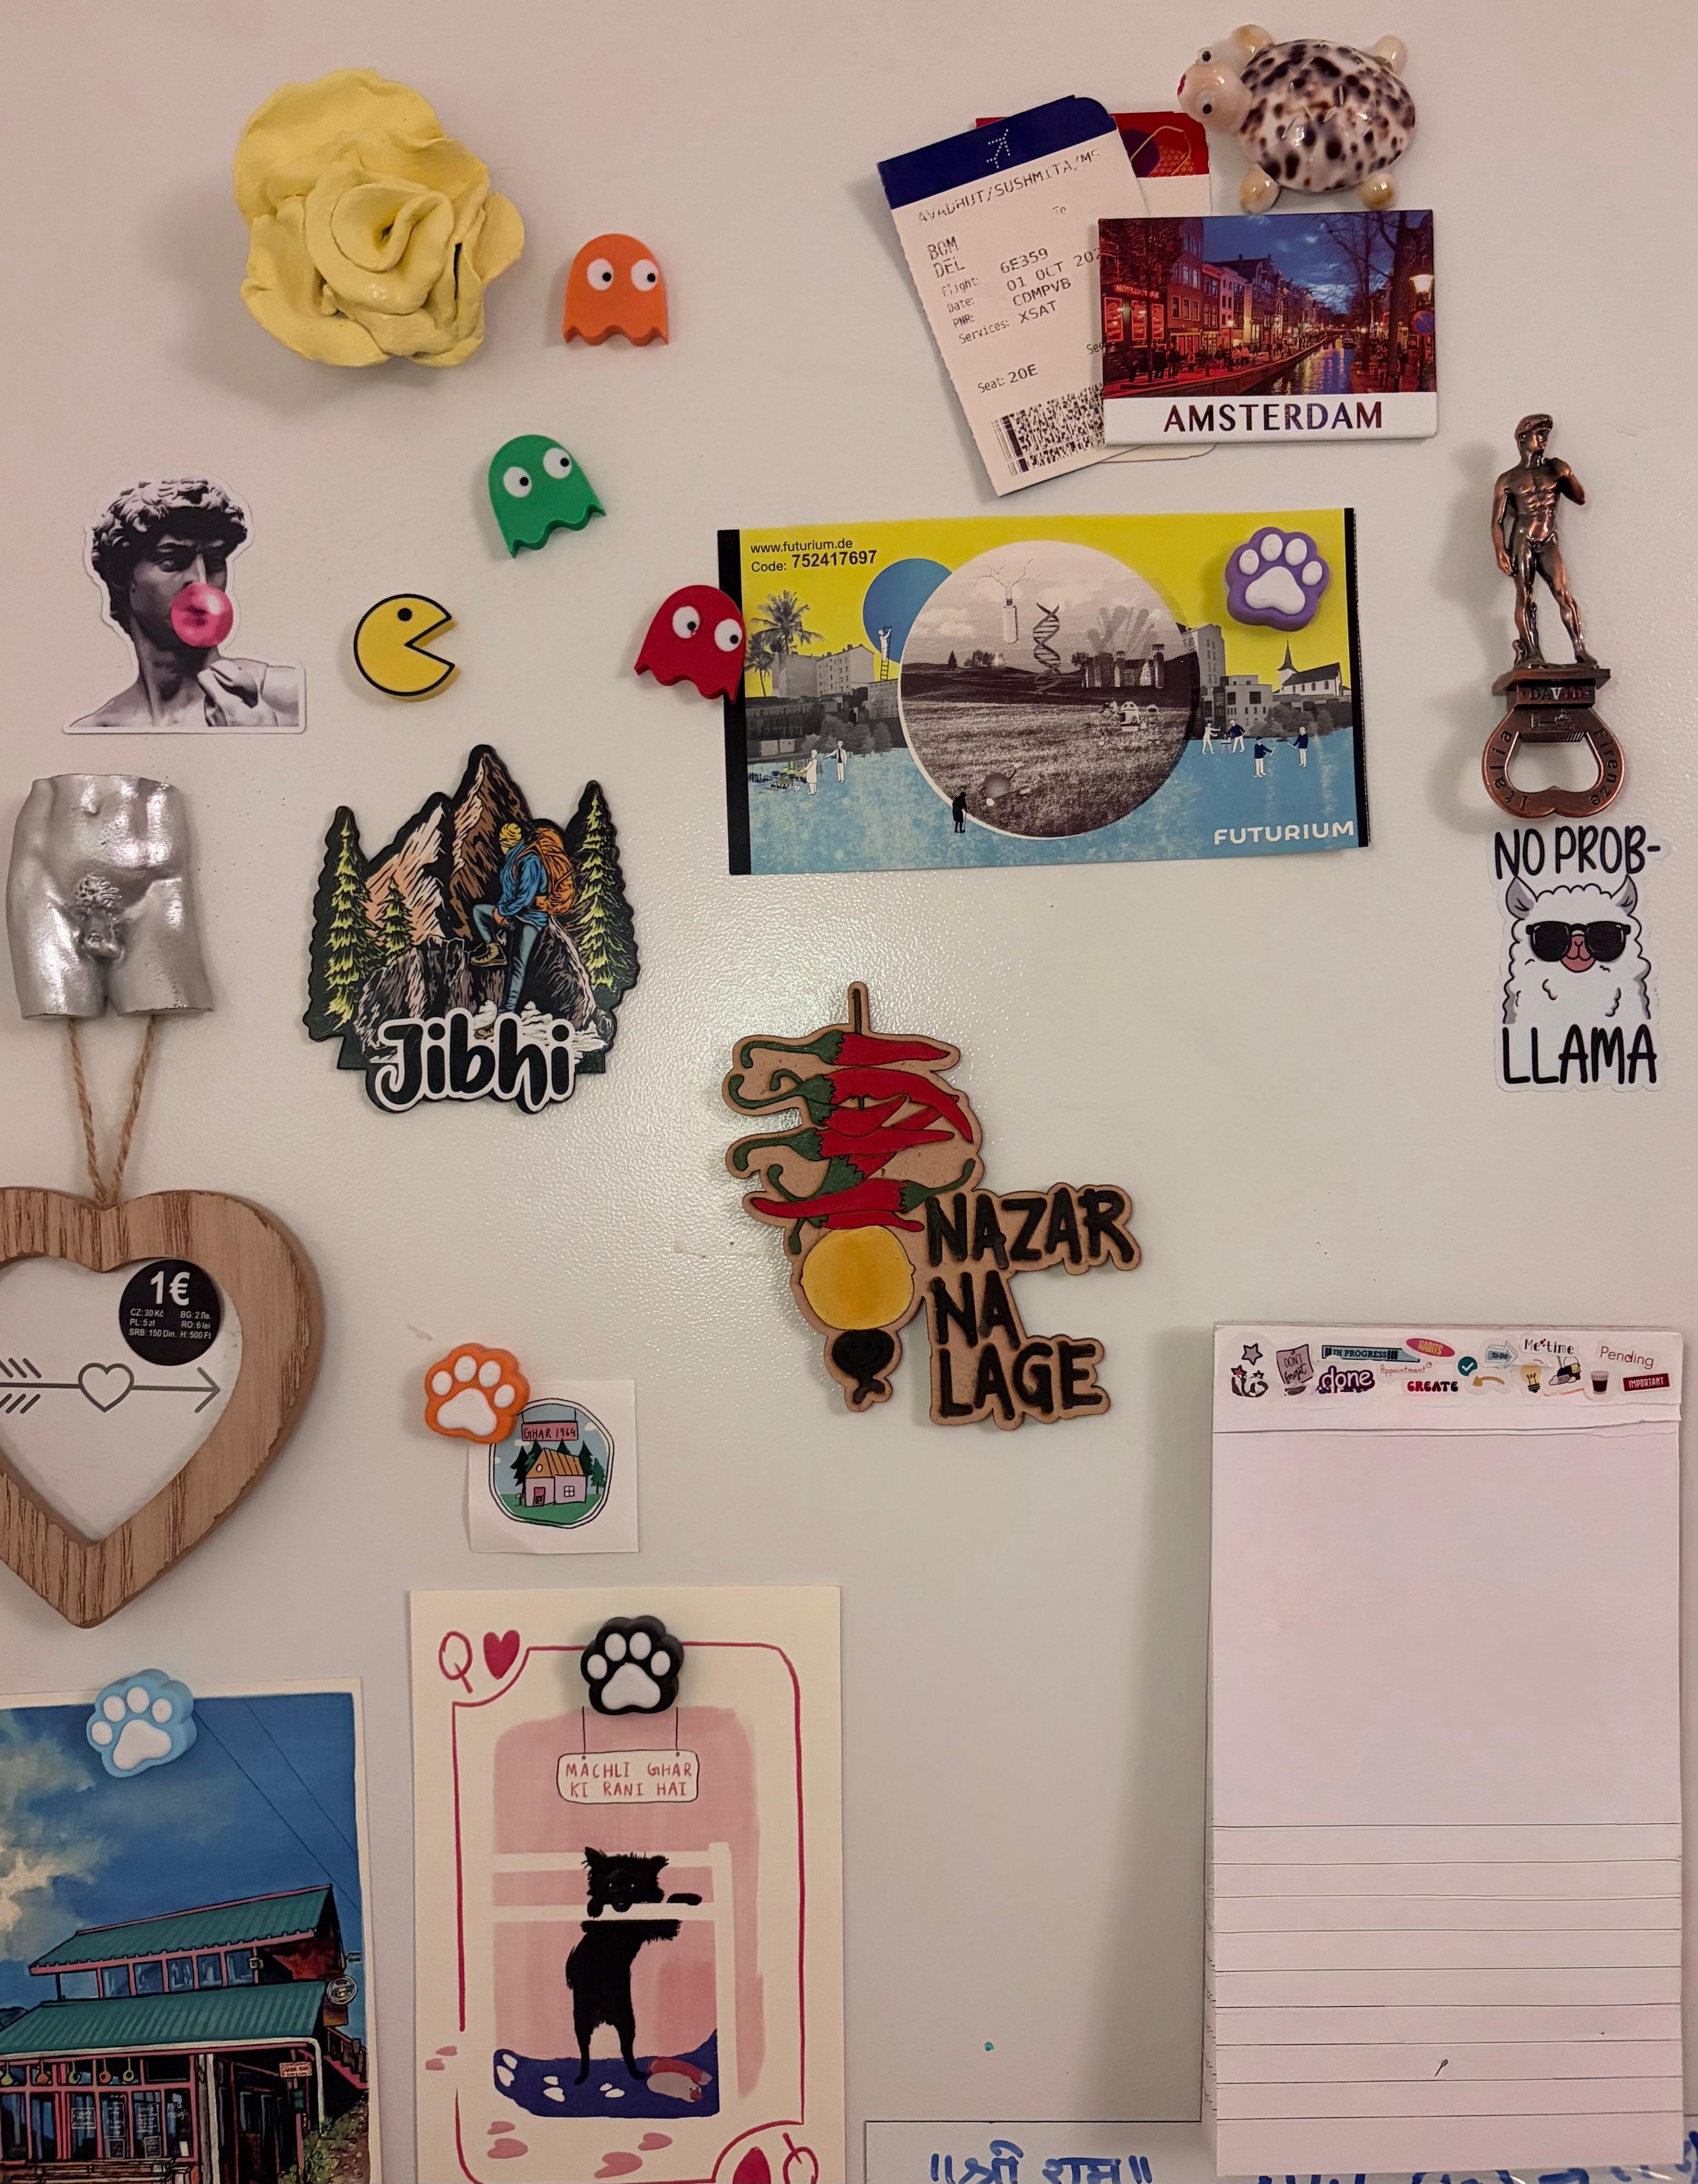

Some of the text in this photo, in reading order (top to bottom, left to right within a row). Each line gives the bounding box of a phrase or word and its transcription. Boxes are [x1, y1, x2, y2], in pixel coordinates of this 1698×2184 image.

[927, 236, 959, 260] BOM
[933, 257, 965, 278] DEL
[942, 248, 1048, 297] Flight: 6E359
[947, 297, 975, 313] Date:
[1036, 261, 1063, 280] OCT
[1073, 247, 1100, 267] 202
[953, 278, 1071, 328] PNR: CDMPVB
[958, 300, 1056, 344] Services: XSAT
[978, 364, 1038, 393] Seat: 20E
[1163, 402, 1382, 432] AMSTERDAM
[751, 538, 853, 553] www.futurium.de
[751, 550, 877, 572] Code: 752417697
[1529, 687, 1584, 700] DAVID
[1589, 728, 1618, 805] Firenze
[1214, 820, 1355, 845] FUTURIUM
[1494, 825, 1661, 879] NO PROB-
[378, 1011, 572, 1109] Jibhi
[1502, 1024, 1657, 1084] LLAMA
[925, 1188, 1135, 1269] NAZAR
[150, 1270, 191, 1306] 1€
[930, 1270, 1021, 1350] NA
[163, 1329, 177, 1338] Din.
[1344, 1349, 1387, 1359] PROGRESS
[1418, 1339, 1443, 1355] HABITS
[1524, 1339, 1574, 1354] Me time
[1600, 1346, 1654, 1370] Pending
[938, 1341, 1103, 1421] LAGE
[1284, 1363, 1307, 1383] forget
[1321, 1367, 1373, 1389] done
[1380, 1364, 1426, 1374] Appointment
[1407, 1381, 1459, 1392] CREATE
[1628, 1376, 1664, 1389] IMPORTANT
[524, 1427, 576, 1440] GHAR 1964
[438, 1631, 473, 1694] Q
[565, 1761, 692, 1778] MACHLI GHAR
[570, 1781, 687, 1798] KI RANI HAI
